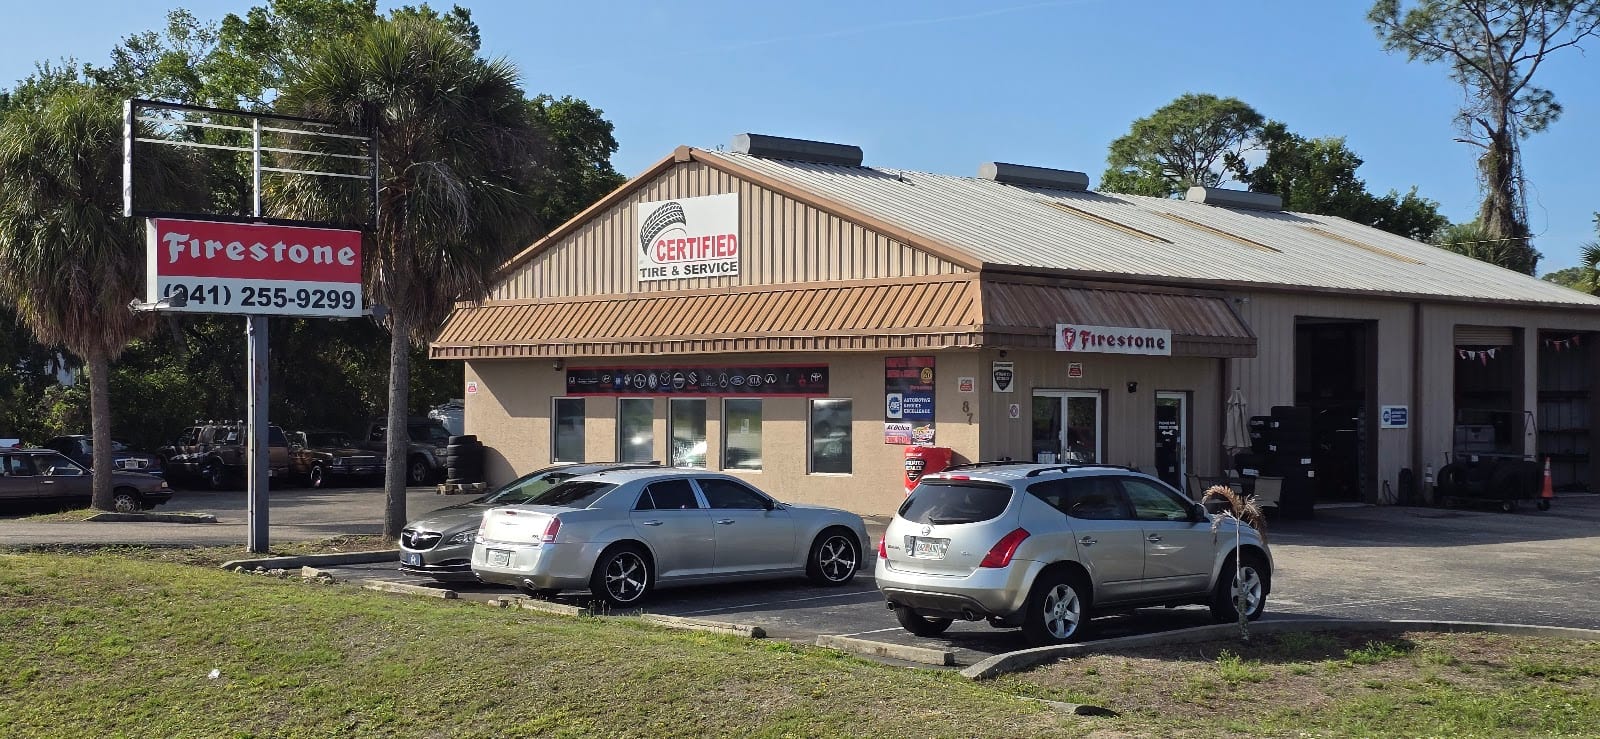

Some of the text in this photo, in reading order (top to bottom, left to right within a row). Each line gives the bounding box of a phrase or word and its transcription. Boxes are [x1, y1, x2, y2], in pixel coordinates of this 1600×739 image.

[162, 232, 356, 266] Firestone
[656, 233, 738, 261] CERTIFIED
[640, 261, 738, 278] TIRE & SERVICE
[240, 286, 356, 310] 255-9299
[1079, 330, 1166, 350] Firestone
